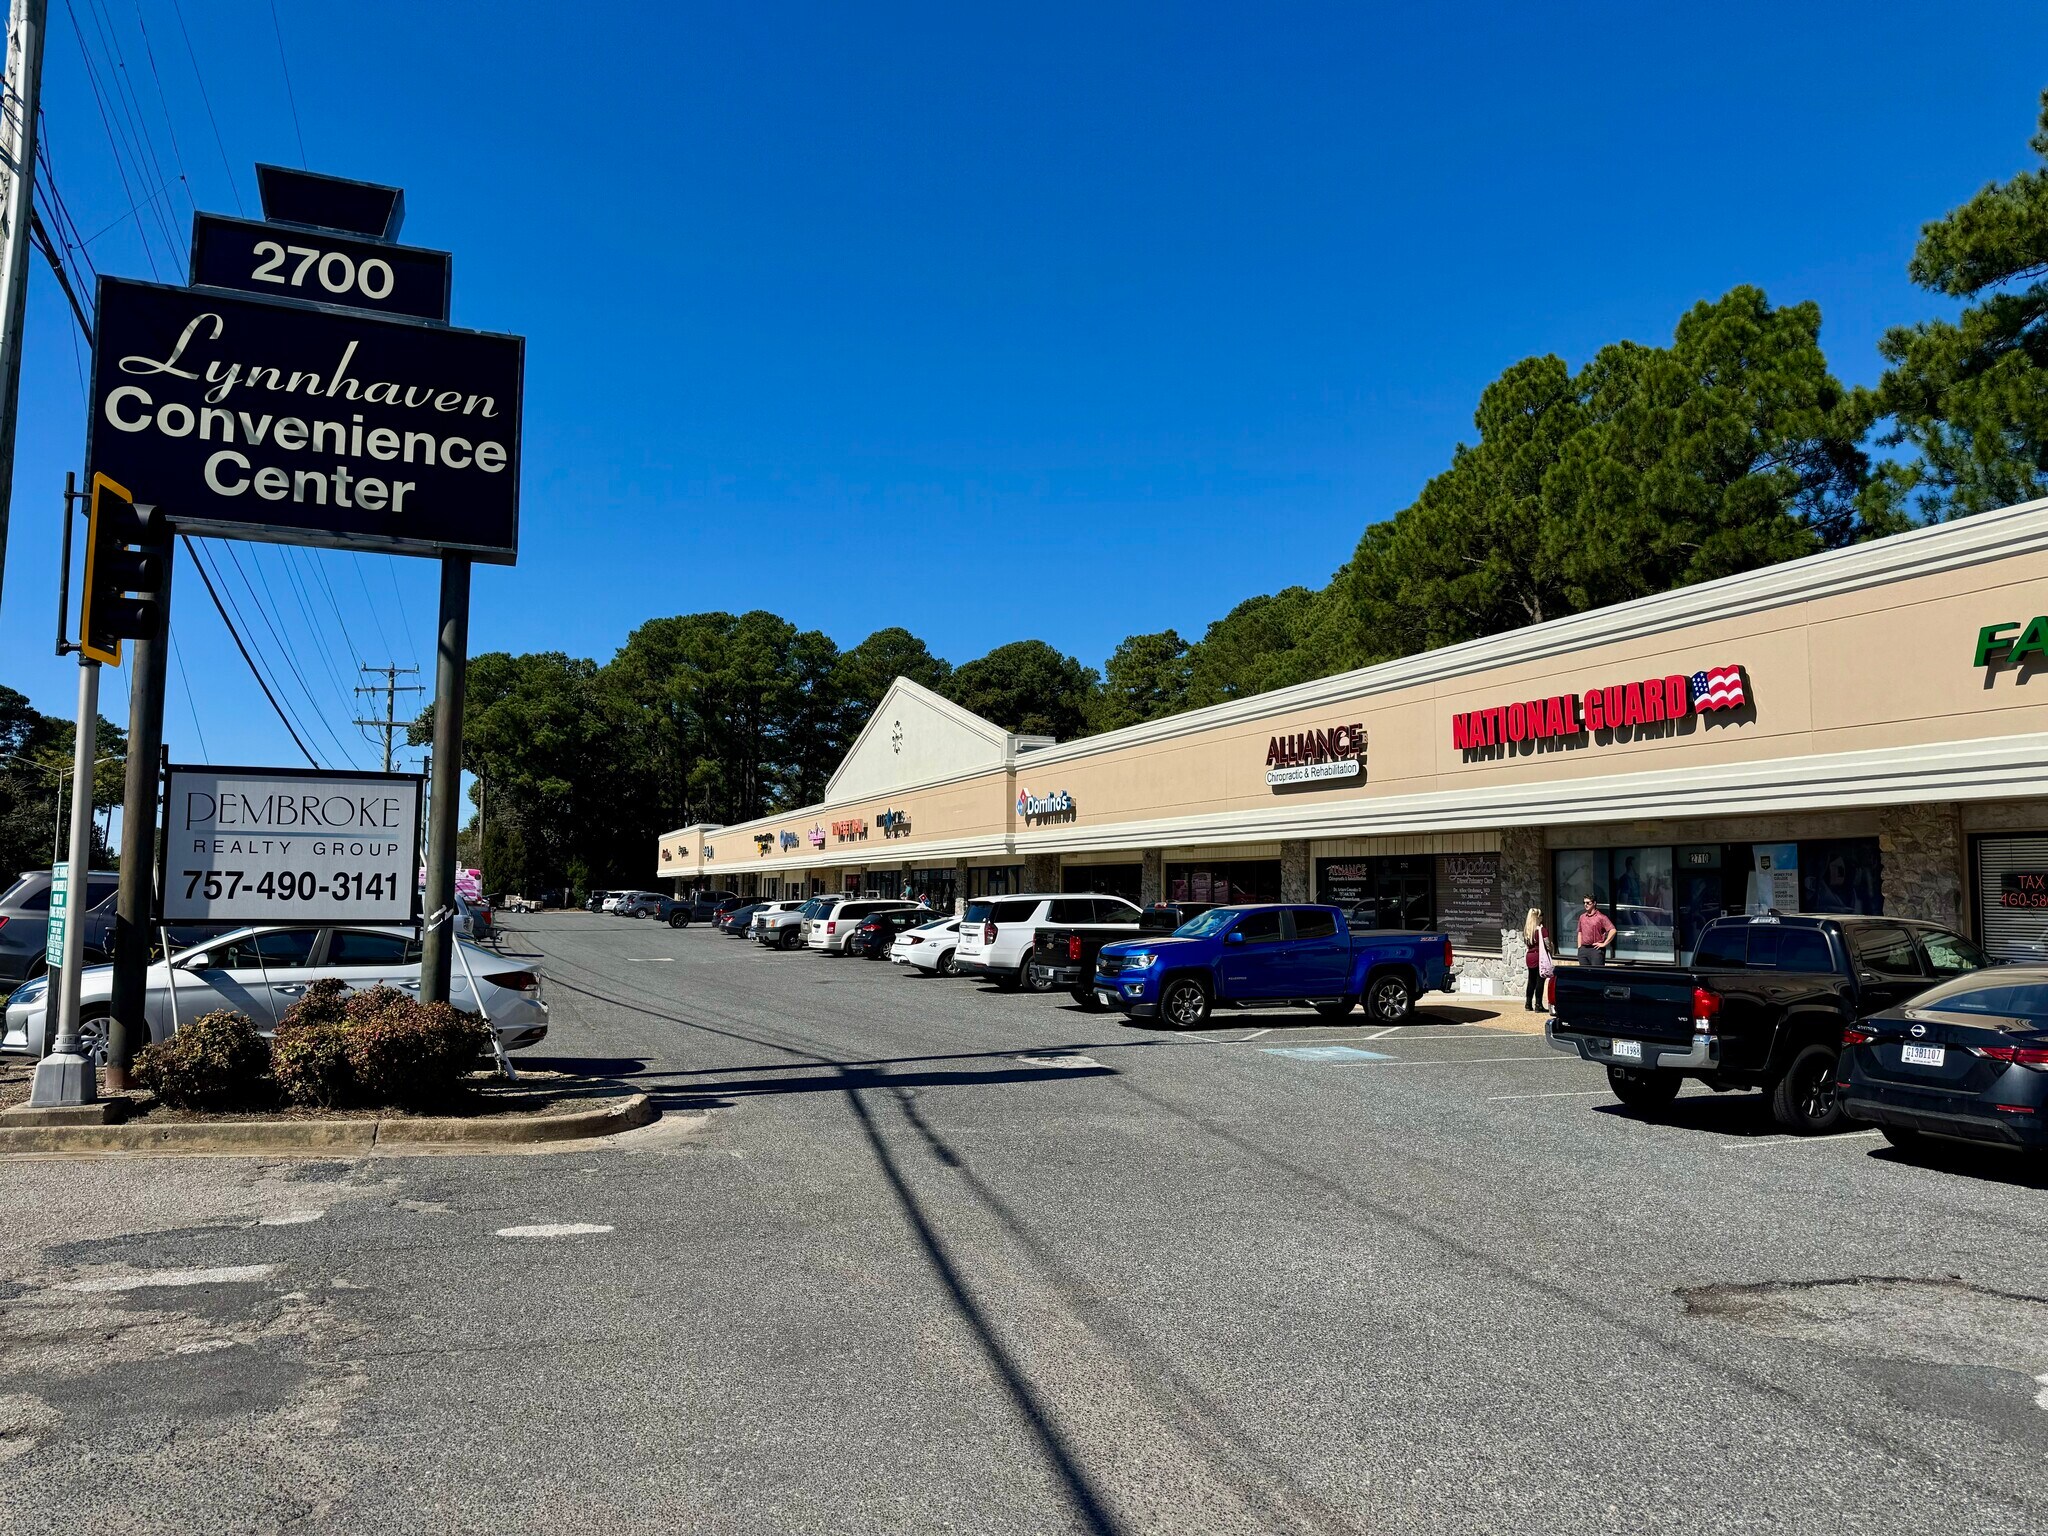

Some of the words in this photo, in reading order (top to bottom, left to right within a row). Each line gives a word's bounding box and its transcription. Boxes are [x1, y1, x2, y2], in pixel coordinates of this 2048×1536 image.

[251, 240, 394, 299] 2700
[118, 312, 499, 418] Lynnhaven
[104, 386, 507, 473] Convenience
[204, 450, 415, 513] Center
[1973, 615, 2048, 667] FA
[1453, 694, 1579, 749] NATIONAL
[1584, 674, 1687, 732] GUARD
[1265, 723, 1363, 765] ALLIANCE
[1267, 769, 1303, 783] Chiropractic
[1304, 768, 1309, 778] &
[1310, 763, 1357, 778] Rehabilitation
[186, 792, 400, 831] PEMBROKE
[1027, 790, 1070, 814] Domino's
[193, 839, 291, 855] REALTY
[313, 842, 398, 857] GROUP
[183, 870, 397, 901] 757-490-3141
[2001, 893, 2048, 907] 460-58
[2018, 875, 2046, 889] TAX
[1558, 934, 1578, 942] CITIZE
